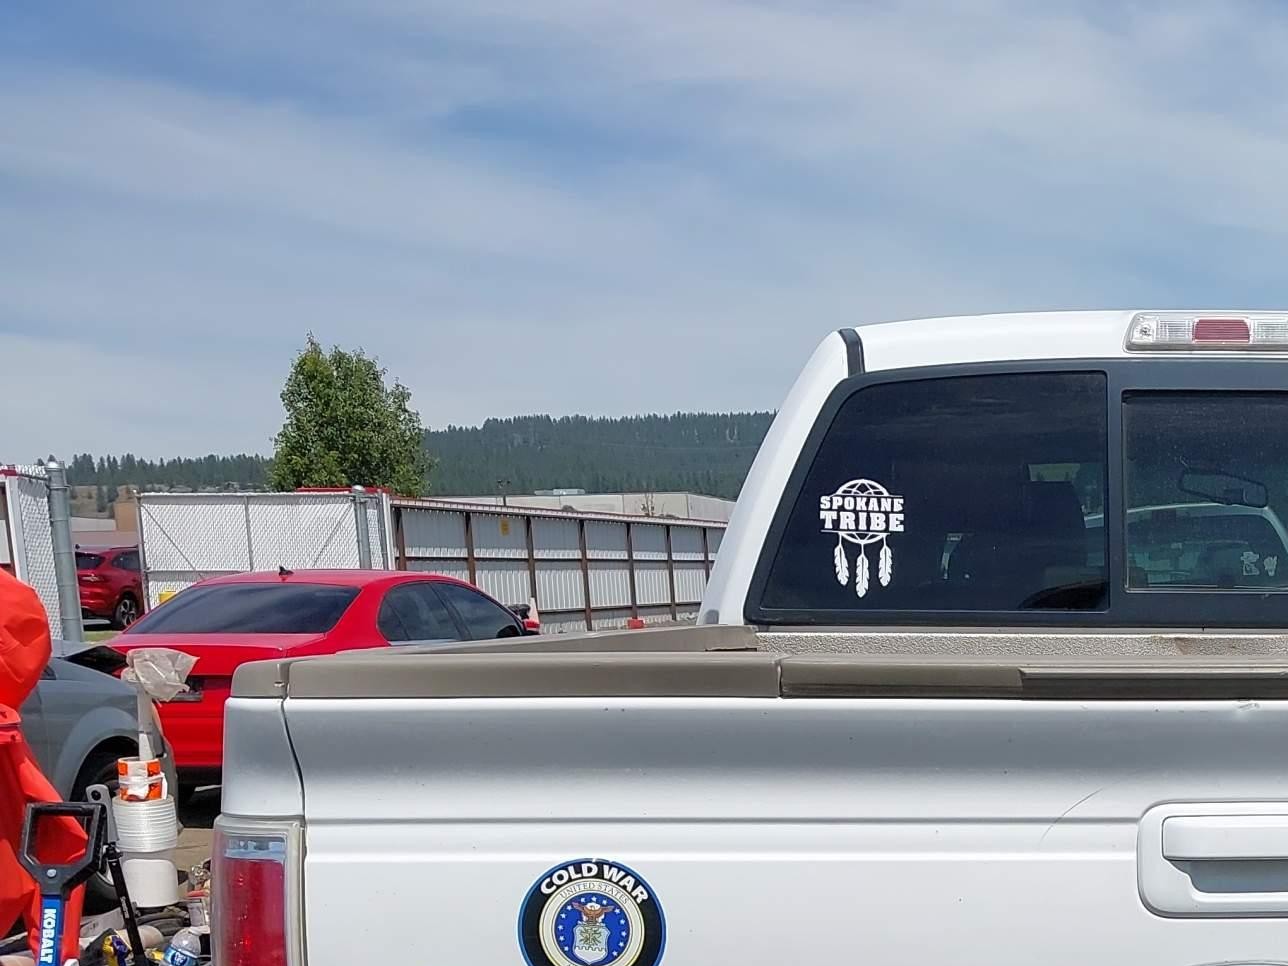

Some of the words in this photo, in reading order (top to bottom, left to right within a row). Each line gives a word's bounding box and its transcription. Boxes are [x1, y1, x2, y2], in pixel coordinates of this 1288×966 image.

[820, 496, 904, 512] SPOKANE
[820, 510, 904, 532] TRIBE
[540, 863, 599, 895] COLD
[602, 864, 649, 904] WAR
[559, 882, 597, 899] UNITED
[597, 882, 629, 905] STATES
[40, 908, 57, 964] KOBALT
